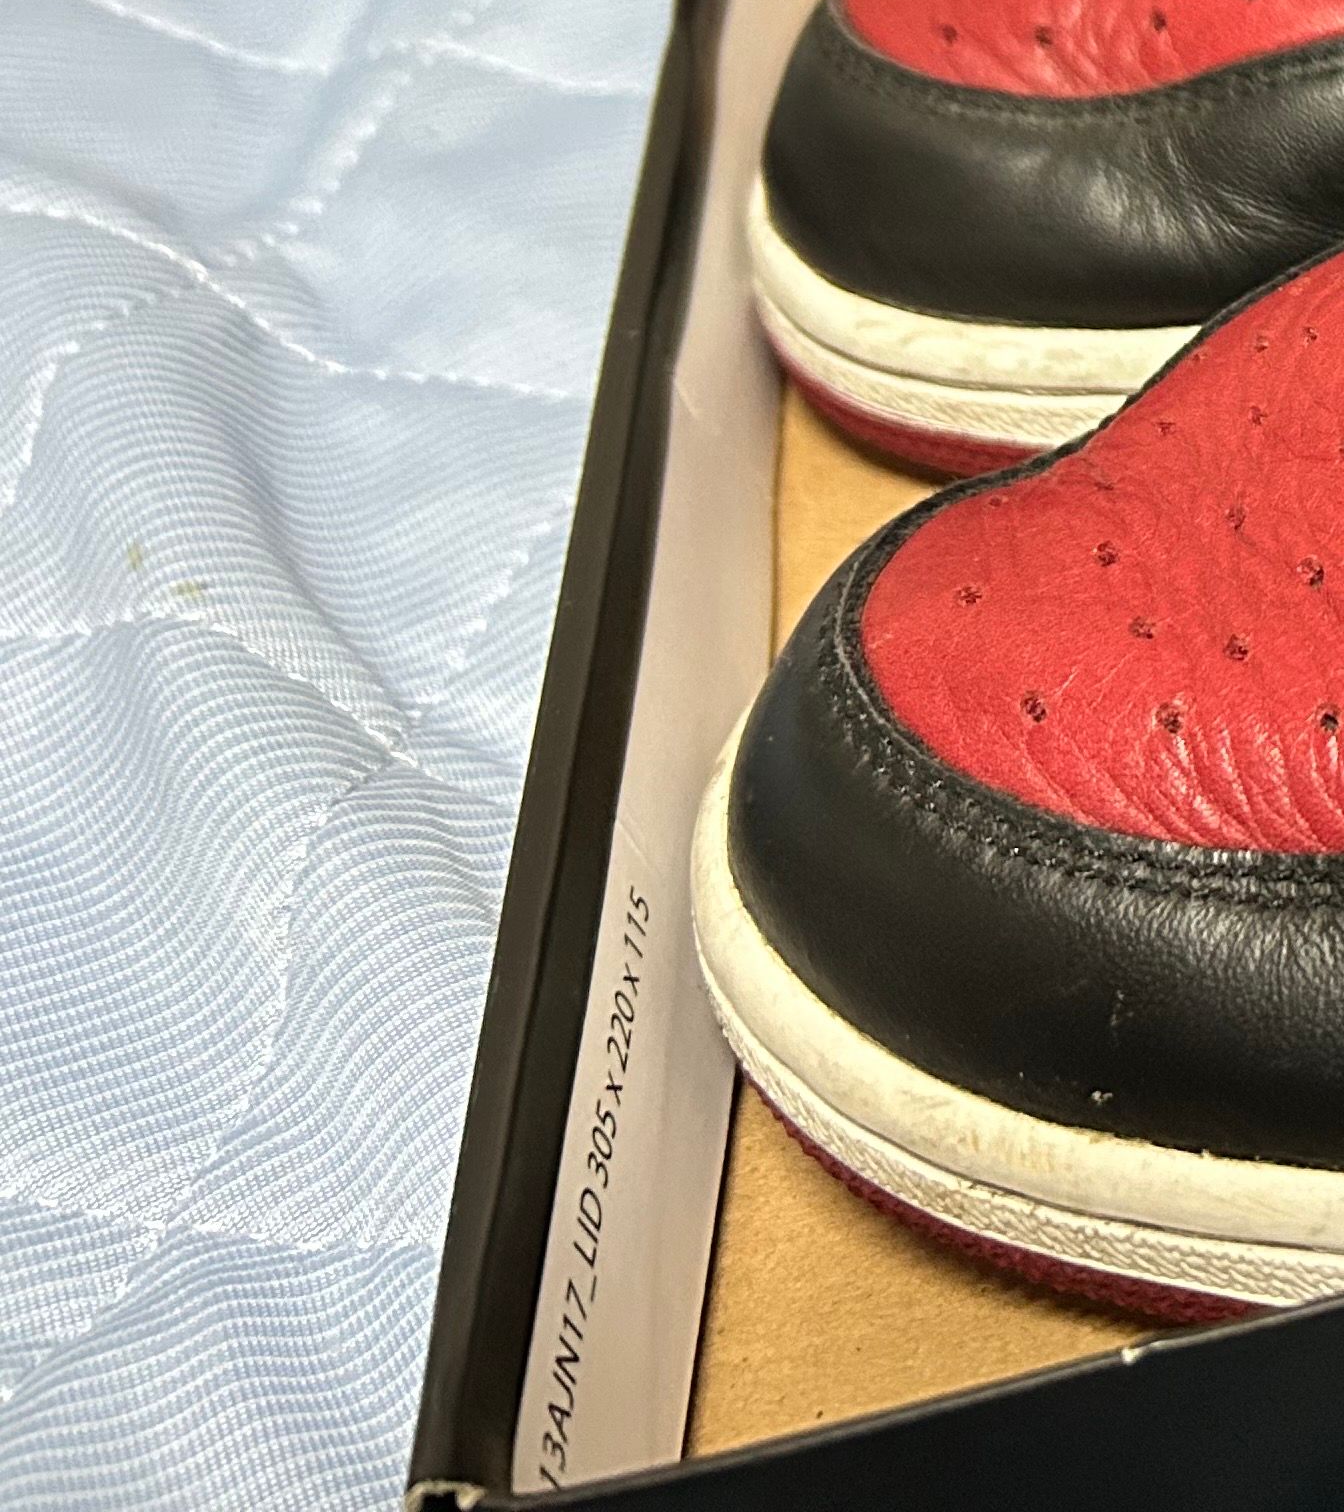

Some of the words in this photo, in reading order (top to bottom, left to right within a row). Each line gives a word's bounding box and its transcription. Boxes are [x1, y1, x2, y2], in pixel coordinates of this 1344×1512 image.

[587, 1098, 617, 1189] 305
[606, 990, 635, 1074] 220
[623, 884, 650, 960] 115
